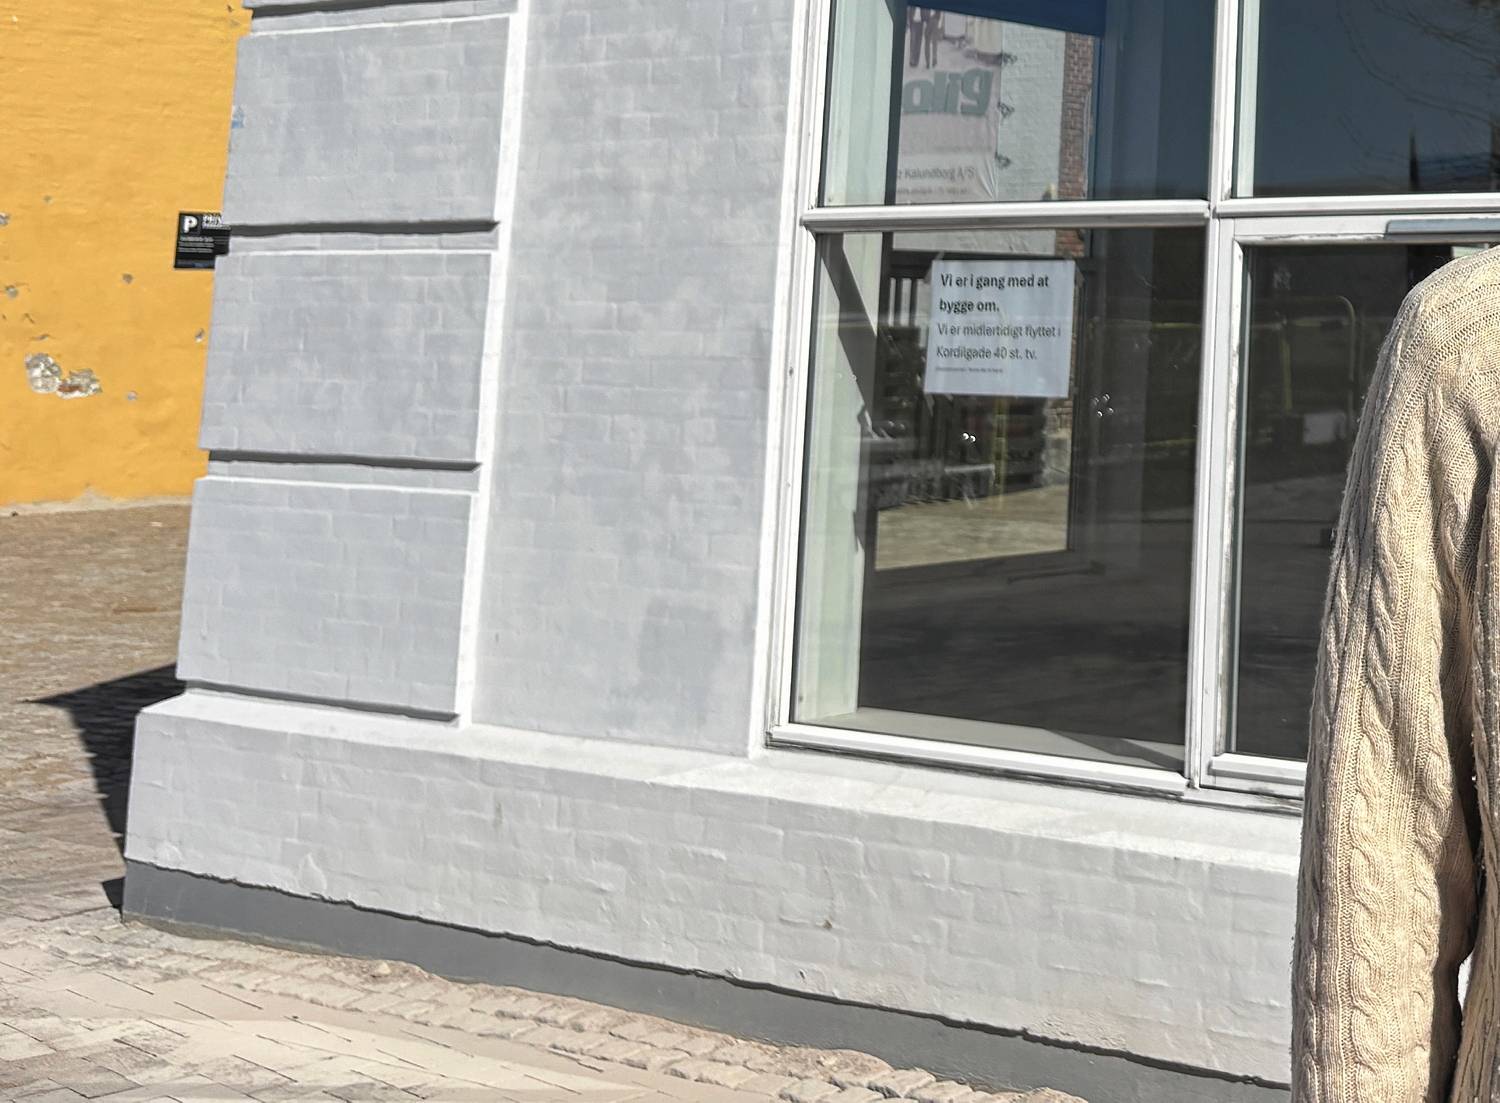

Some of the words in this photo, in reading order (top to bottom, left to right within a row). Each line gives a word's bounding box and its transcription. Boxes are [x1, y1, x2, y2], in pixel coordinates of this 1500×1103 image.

[902, 68, 994, 116] olig
[940, 273, 952, 287] Vi
[955, 276, 969, 287] er
[970, 273, 974, 287] i
[976, 276, 1005, 290] gang
[1007, 273, 1035, 287] med
[1037, 275, 1049, 287] at
[939, 298, 974, 314] bygge
[976, 301, 1000, 312] om.
[937, 323, 948, 335] Vi
[949, 325, 960, 335] er
[962, 323, 1023, 339] midlertidigt
[1025, 324, 1056, 340] flyttet
[993, 347, 1007, 359] 40
